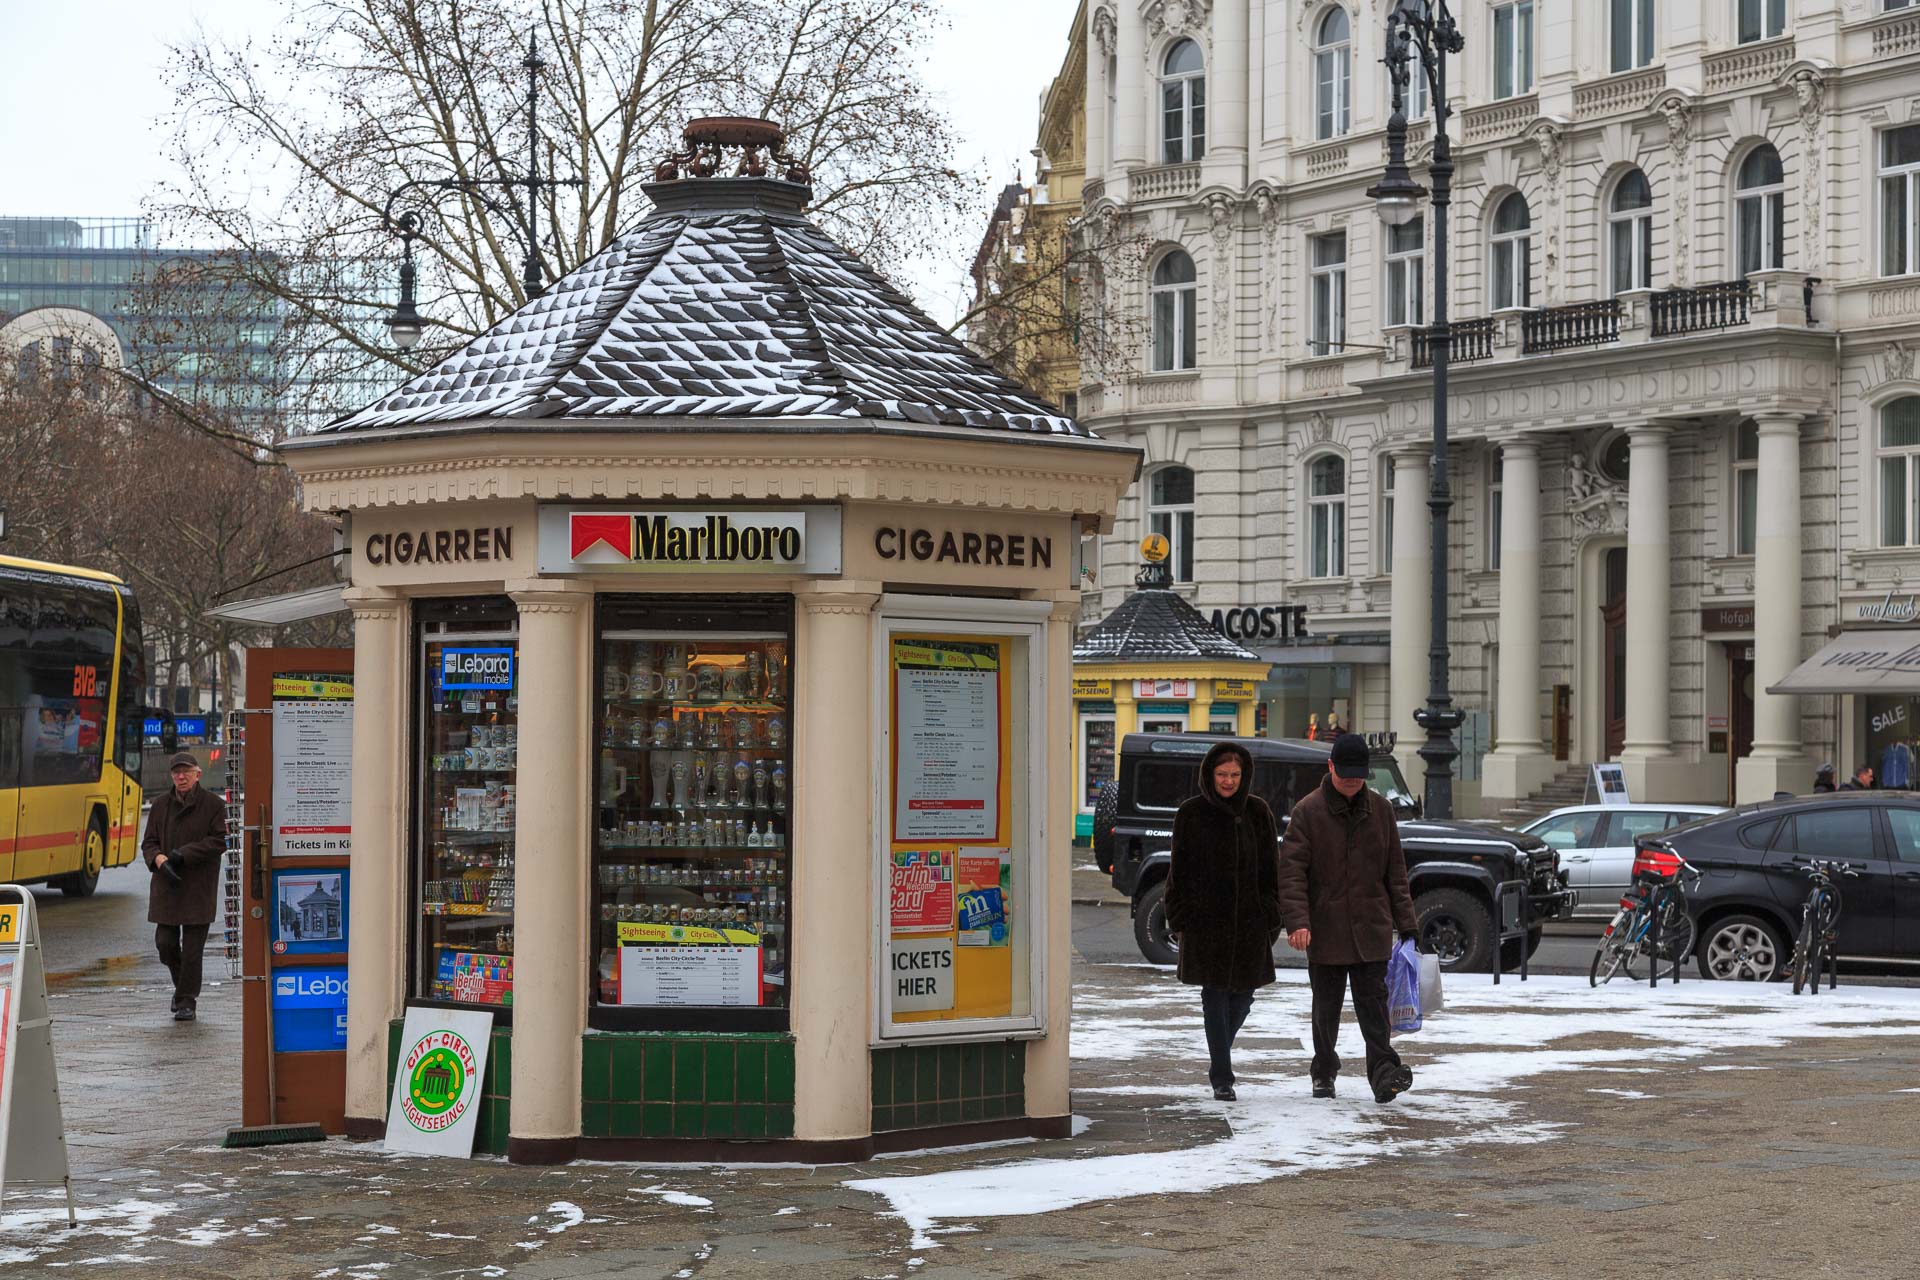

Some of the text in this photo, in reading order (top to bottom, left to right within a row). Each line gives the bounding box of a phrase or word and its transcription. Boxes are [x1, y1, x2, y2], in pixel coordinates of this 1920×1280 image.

[366, 526, 513, 564] CIGARREN
[633, 516, 800, 561] Marlboro
[875, 527, 1052, 568] CIGARREN
[457, 653, 510, 673] Lebara
[484, 675, 508, 684] mobile
[1872, 705, 1906, 732] SALE
[285, 840, 321, 849] Tickets
[324, 840, 336, 849] im
[906, 881, 935, 891] Welcome
[622, 926, 666, 938] Sightseeing
[691, 930, 702, 938] City
[457, 973, 483, 988] Berlin
[898, 977, 937, 996] HIER
[403, 1097, 465, 1130] SIGHTSEEING
